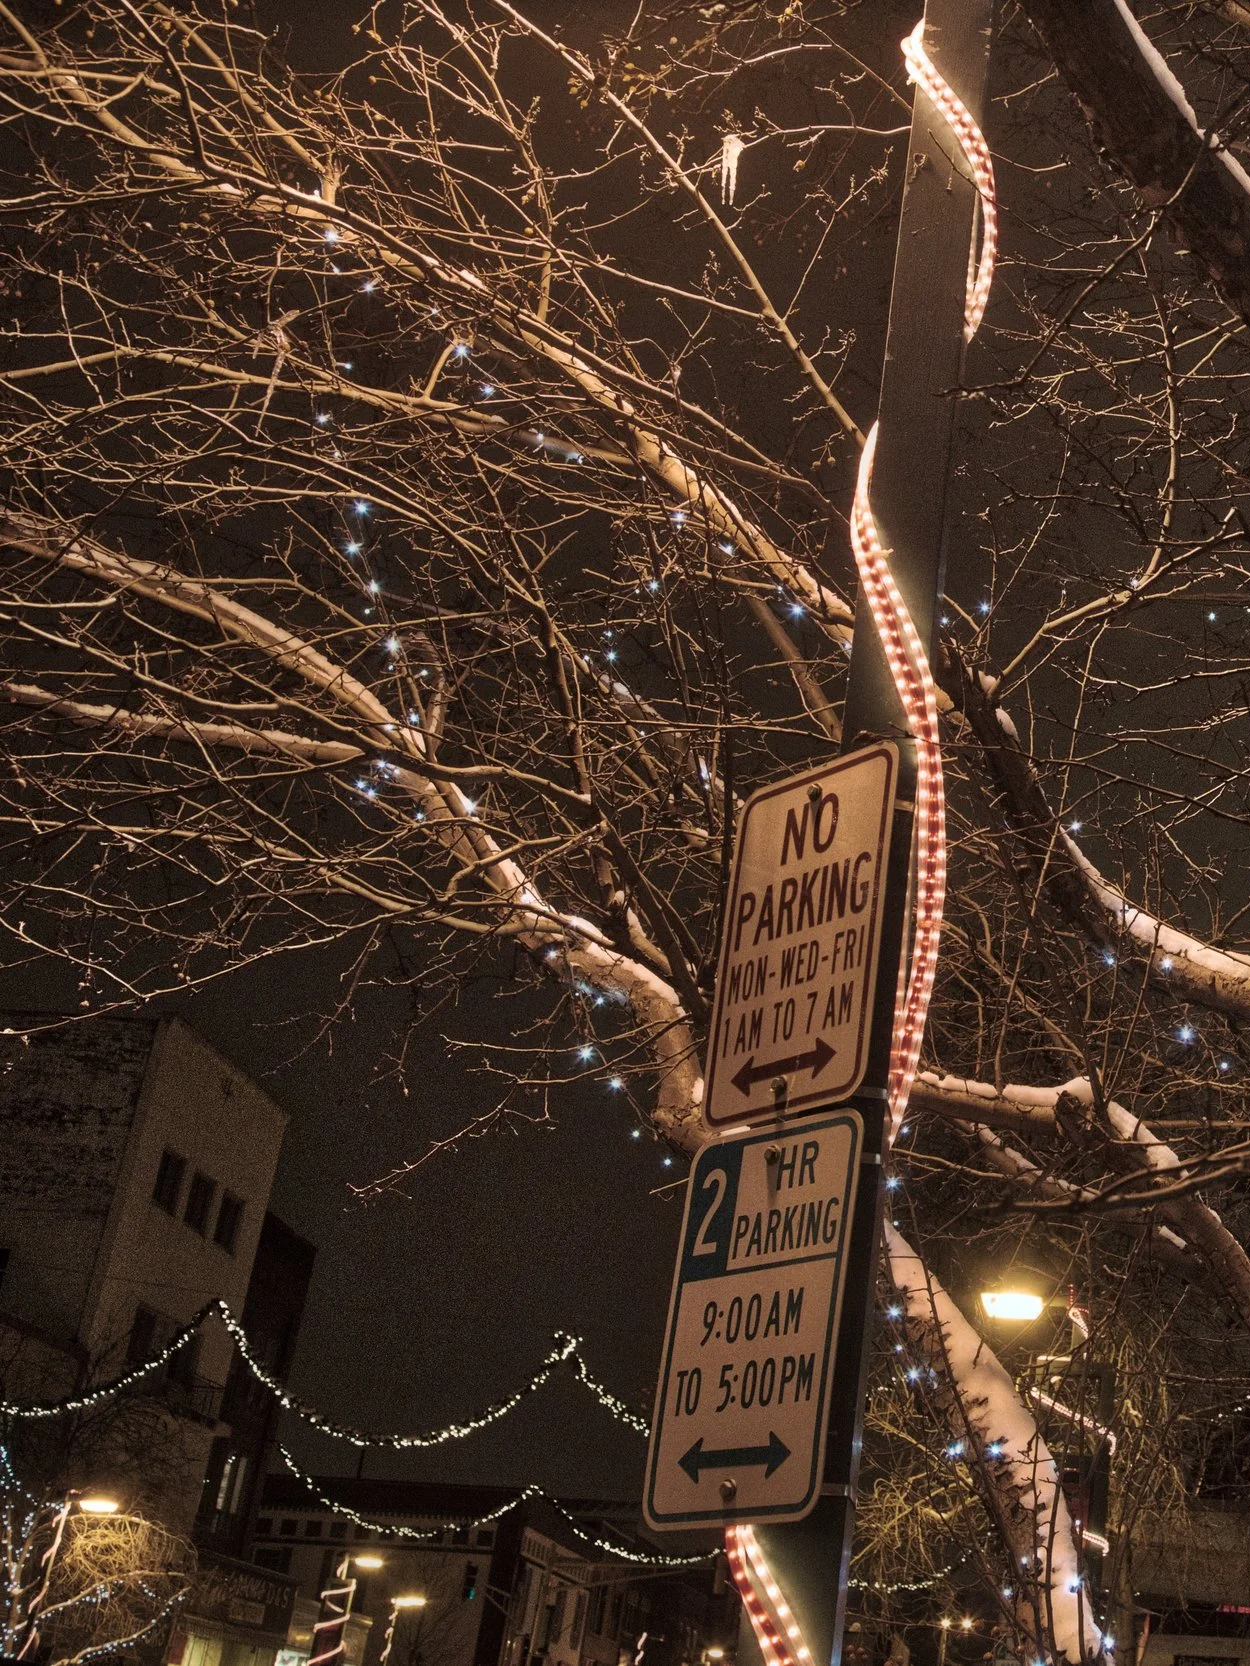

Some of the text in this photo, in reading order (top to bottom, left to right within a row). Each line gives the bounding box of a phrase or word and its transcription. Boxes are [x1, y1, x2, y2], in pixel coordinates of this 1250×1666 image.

[780, 793, 839, 866] NO
[734, 852, 872, 951] PARKING
[728, 925, 865, 1006] MON-WED-FRI
[773, 998, 795, 1044] TO
[692, 1140, 819, 1257] 2 HR
[732, 1197, 839, 1259] PARKING
[700, 1287, 804, 1346] 9:00AM
[675, 1353, 815, 1416] TO 5:00PM
